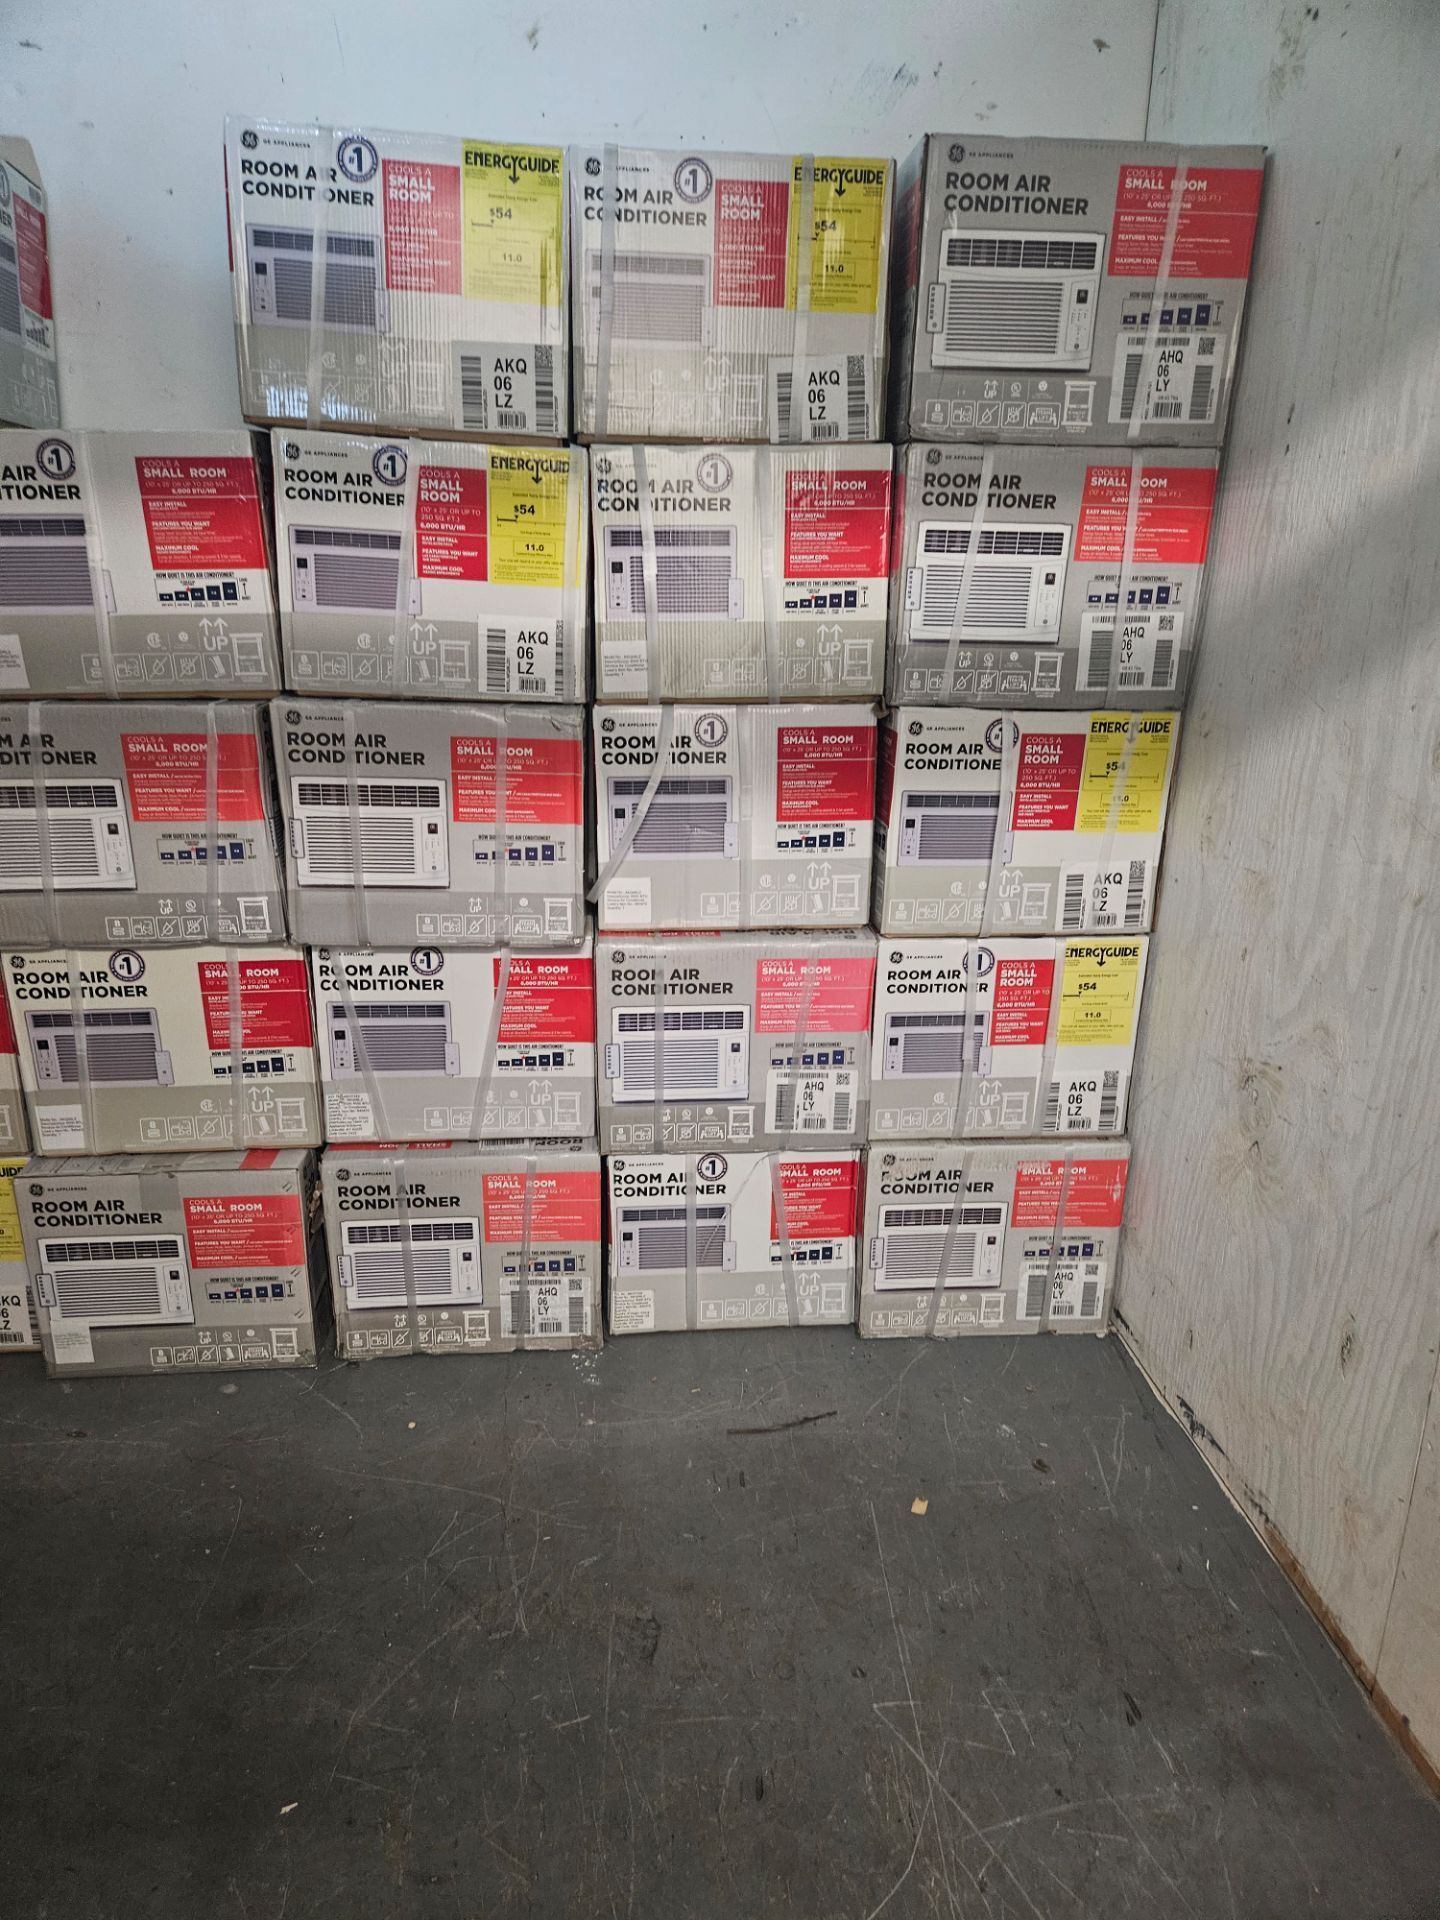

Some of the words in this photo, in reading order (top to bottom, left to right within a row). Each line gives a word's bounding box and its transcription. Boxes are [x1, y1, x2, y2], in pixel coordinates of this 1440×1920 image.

[465, 151, 560, 173] ENERGYGUIDE
[242, 159, 299, 179] ROOM
[306, 166, 337, 182] AR
[794, 167, 884, 185] EERGYGUIDE
[388, 175, 435, 191] SMALL
[946, 173, 1009, 193] ROOM
[1016, 176, 1050, 192] AIR
[1125, 179, 1164, 190] SMALL
[243, 180, 374, 206] CONDITONER
[389, 189, 432, 204] ROOM
[644, 191, 673, 205] AIR
[721, 194, 764, 208] SMALL
[944, 195, 1088, 215] CONDITIONER
[489, 207, 513, 220] $54
[721, 208, 761, 220] ROOM
[815, 221, 837, 232] $54
[825, 265, 844, 273] 11.0
[1159, 351, 1183, 363] AHQ
[494, 358, 527, 374] AKQ
[1157, 365, 1168, 377] 06
[494, 376, 512, 391] 06
[808, 371, 840, 385] AKQ
[1156, 379, 1170, 392] LY
[495, 394, 513, 408] LZ
[808, 389, 825, 403] 06
[808, 407, 826, 420] LZ
[491, 456, 569, 472] ENERGYGUID
[2, 466, 37, 480] AIR
[144, 468, 184, 477] SMALL
[191, 468, 226, 477] ROOM
[284, 468, 338, 484] ROOM
[344, 473, 372, 487] AIR
[420, 469, 449, 478] COOLS
[453, 470, 460, 478] A
[420, 479, 463, 491] SMALL
[661, 480, 693, 493] AIR
[792, 481, 827, 490] SMALL
[833, 481, 866, 490] ROOM
[924, 473, 982, 489] ROOM
[990, 475, 1022, 490] AIR
[1091, 477, 1127, 487] SMALL
[420, 491, 460, 503] ROOM
[922, 492, 1056, 509] CONDTIONER
[514, 504, 535, 515] $54
[598, 498, 731, 511] CONITIONER
[517, 631, 548, 645] AKQ
[1123, 627, 1144, 638] AHQ
[205, 639, 227, 650] UP
[414, 641, 436, 654] UP
[517, 647, 533, 659] 06
[1120, 652, 1133, 663] LY
[517, 661, 534, 674] LZ
[1091, 722, 1170, 733] ENERGGUIDE
[287, 732, 345, 746] ROOM
[354, 735, 387, 747] AIR
[601, 736, 656, 749] ROOM
[783, 736, 817, 744] SMALL
[823, 735, 854, 744] ROOM
[129, 744, 167, 752] SMALL
[174, 744, 208, 752] ROOM
[457, 746, 493, 756] SMALL
[905, 743, 954, 755] ROOM
[958, 744, 983, 755] AIR
[1025, 745, 1063, 754] SMALL
[288, 749, 424, 765] CONDTIONER
[602, 752, 727, 764] CONDIIONER
[1024, 755, 1059, 764] ROOM
[904, 759, 1000, 770] CONDITIONE
[808, 877, 830, 890] UP
[1094, 873, 1122, 884] AKQ
[1000, 885, 1020, 898] UP
[1092, 888, 1107, 898] 06
[246, 968, 279, 976] ROOM
[380, 965, 408, 976] AIR
[538, 965, 568, 973] ROOM
[670, 969, 699, 979] AIR
[762, 967, 794, 975] SMALL
[1001, 970, 1037, 978] SMALL
[14, 972, 70, 984] ROOM
[79, 971, 109, 983] AIR
[888, 970, 935, 980] ROOM
[939, 970, 961, 979] AIR
[1000, 978, 1033, 987] ROOM
[1078, 983, 1097, 991] $54
[15, 986, 147, 999] CONDTIONER
[804, 1082, 824, 1091] AHQ
[1069, 1082, 1096, 1092] AKQ
[531, 1094, 551, 1105] UP
[803, 1092, 813, 1100] 06
[980, 1095, 1001, 1106] UP
[1068, 1094, 1083, 1104] 06
[252, 1100, 274, 1113] UP
[803, 1102, 814, 1111] LY
[1067, 1106, 1081, 1116] LZ
[779, 1169, 808, 1177] SMALL
[813, 1168, 841, 1176] ROOM
[936, 1170, 962, 1180] AIR
[1022, 1167, 1053, 1175] SMALL
[488, 1180, 521, 1188] SMALL
[614, 1173, 662, 1184] ROOM
[338, 1186, 390, 1197] ROOM
[32, 1200, 87, 1213] ROOM
[94, 1200, 124, 1211] AIR
[190, 1203, 225, 1212] SMALL
[230, 1203, 262, 1211] ROOM
[33, 1213, 162, 1227] CONDITIONER
[1055, 1272, 1074, 1281] AHQ
[800, 1286, 819, 1296] UP
[1053, 1282, 1063, 1290] 06
[538, 1288, 557, 1296] AHQ
[1053, 1290, 1064, 1299] LY
[537, 1306, 549, 1315] LY
